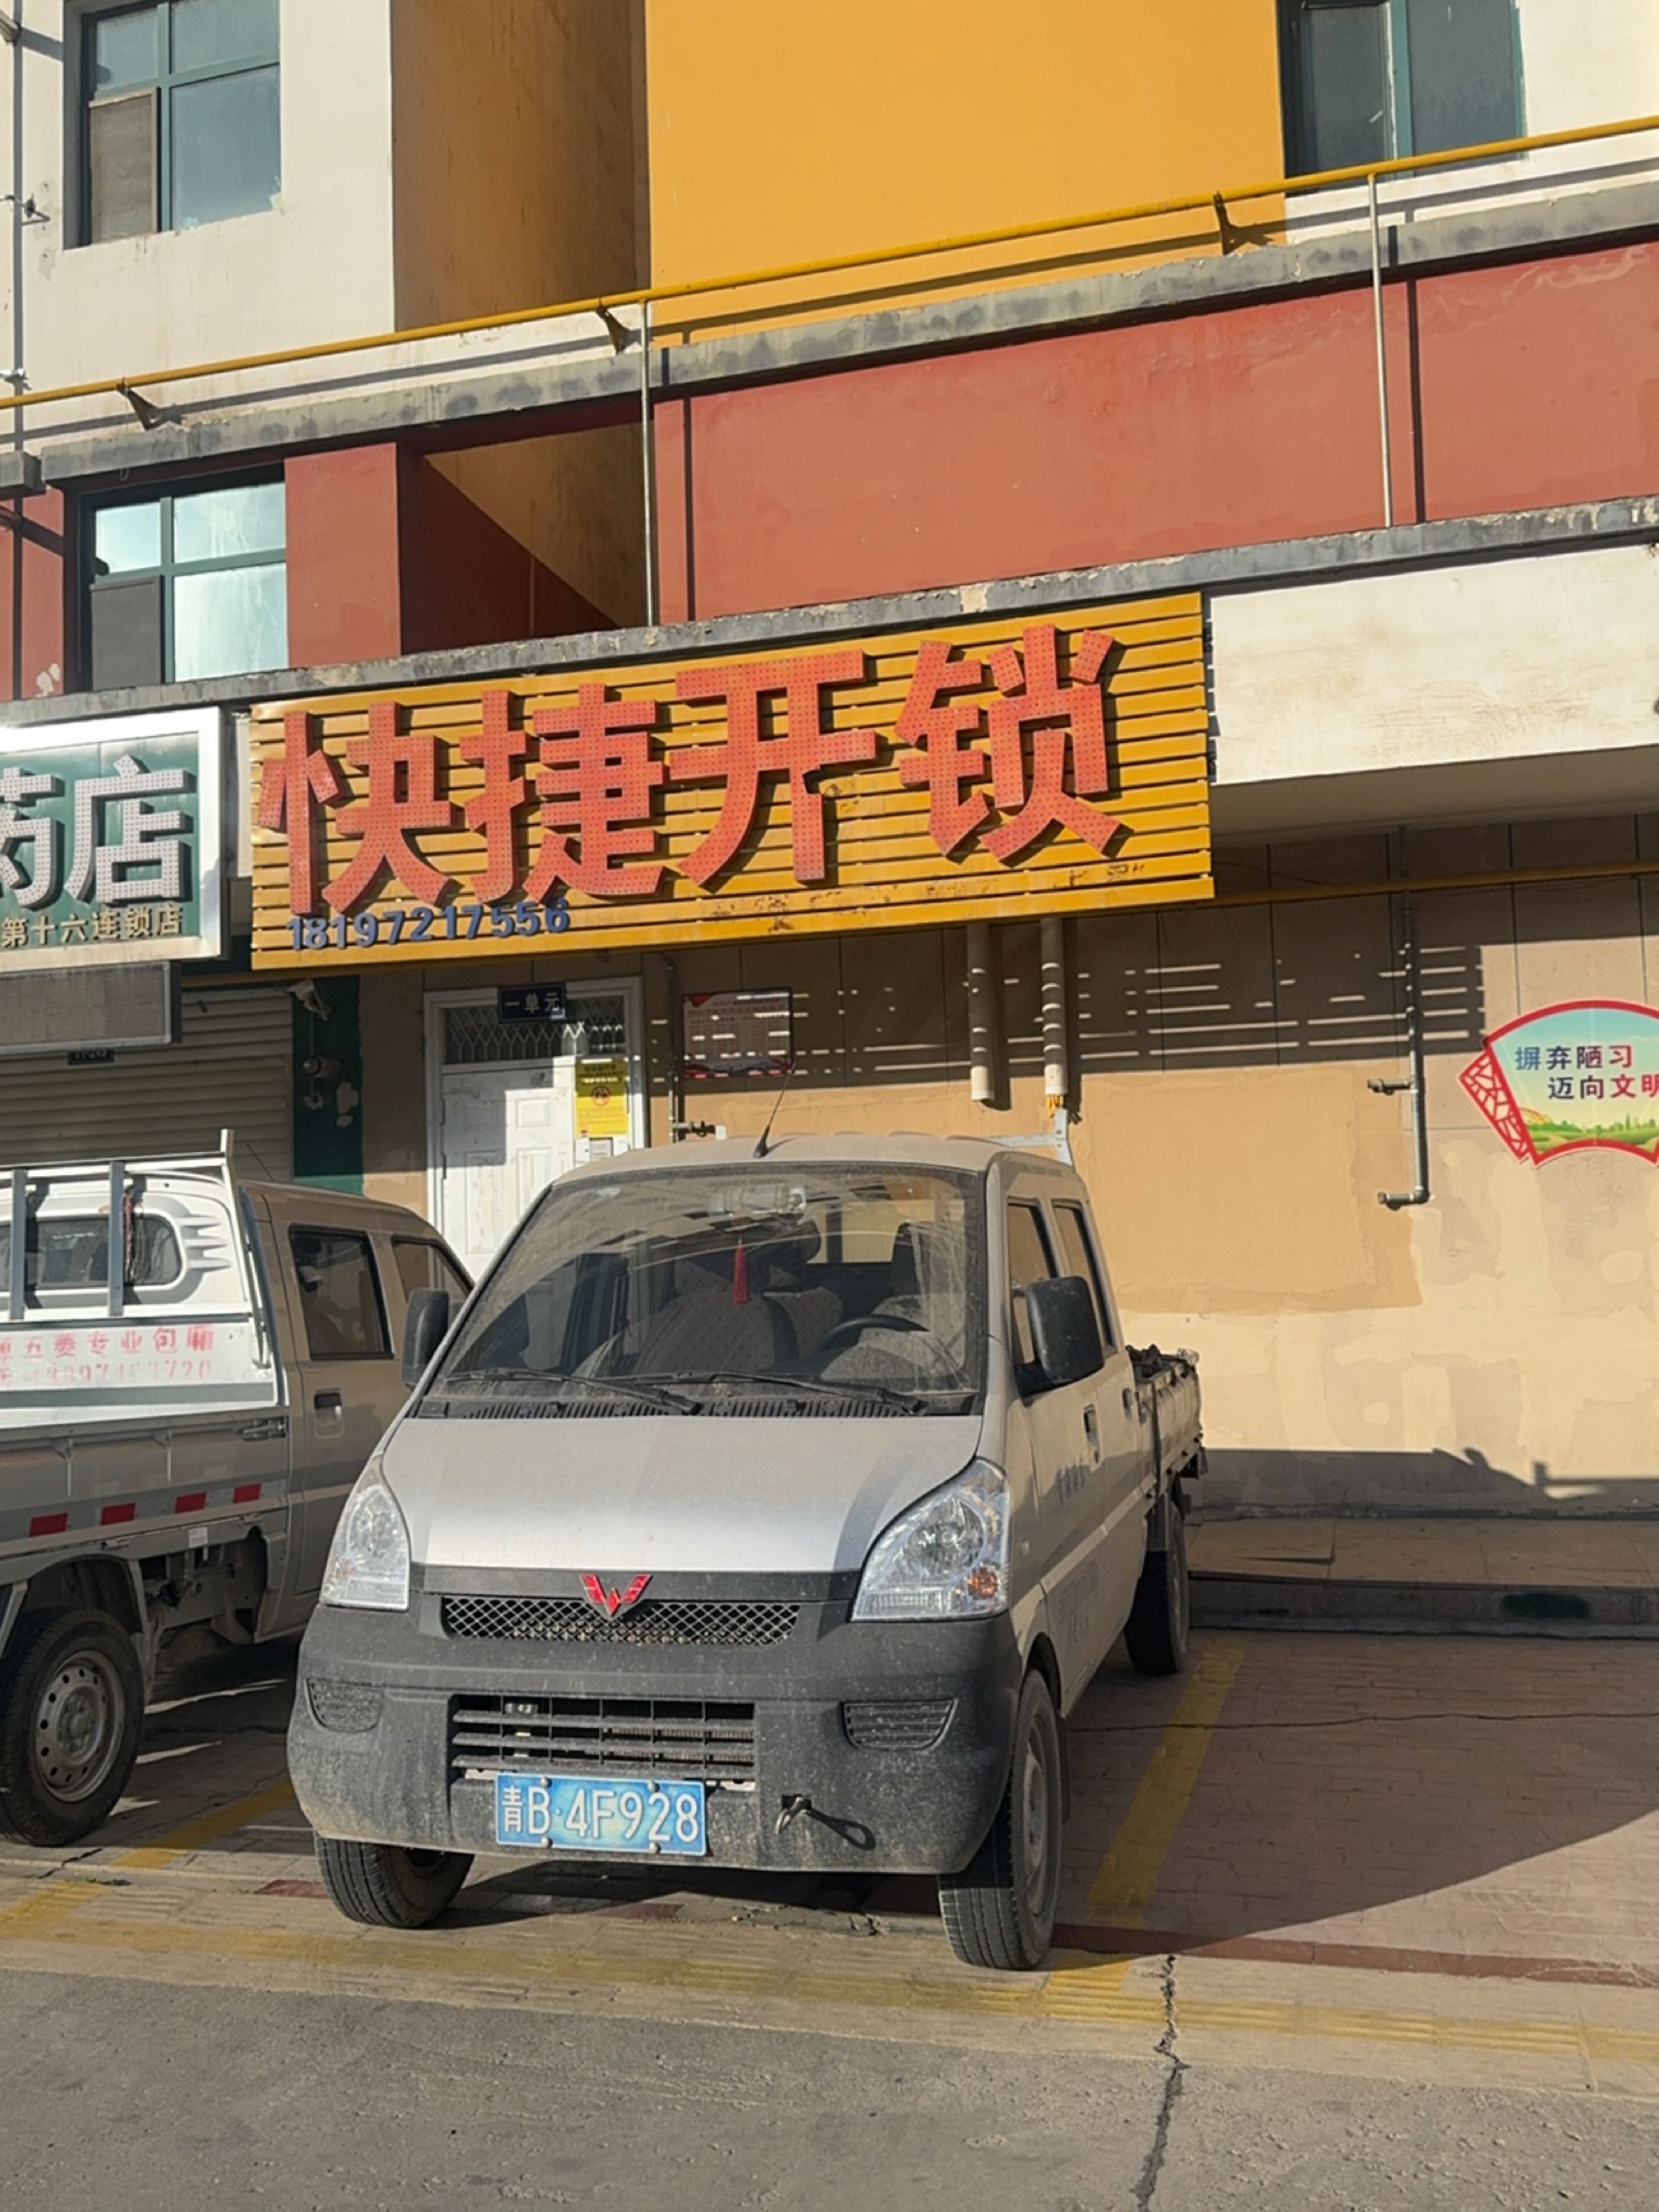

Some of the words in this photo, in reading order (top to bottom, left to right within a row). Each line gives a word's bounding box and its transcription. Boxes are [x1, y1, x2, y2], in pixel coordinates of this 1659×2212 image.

[260, 625, 1125, 914] 快捷开锁
[3, 904, 184, 948] 第十六连锁店
[286, 897, 570, 951] 18197217556
[505, 992, 559, 1014] 一单元
[1515, 1045, 1633, 1070] 摒弃陋习
[1548, 1073, 1659, 1100] 迈向文明
